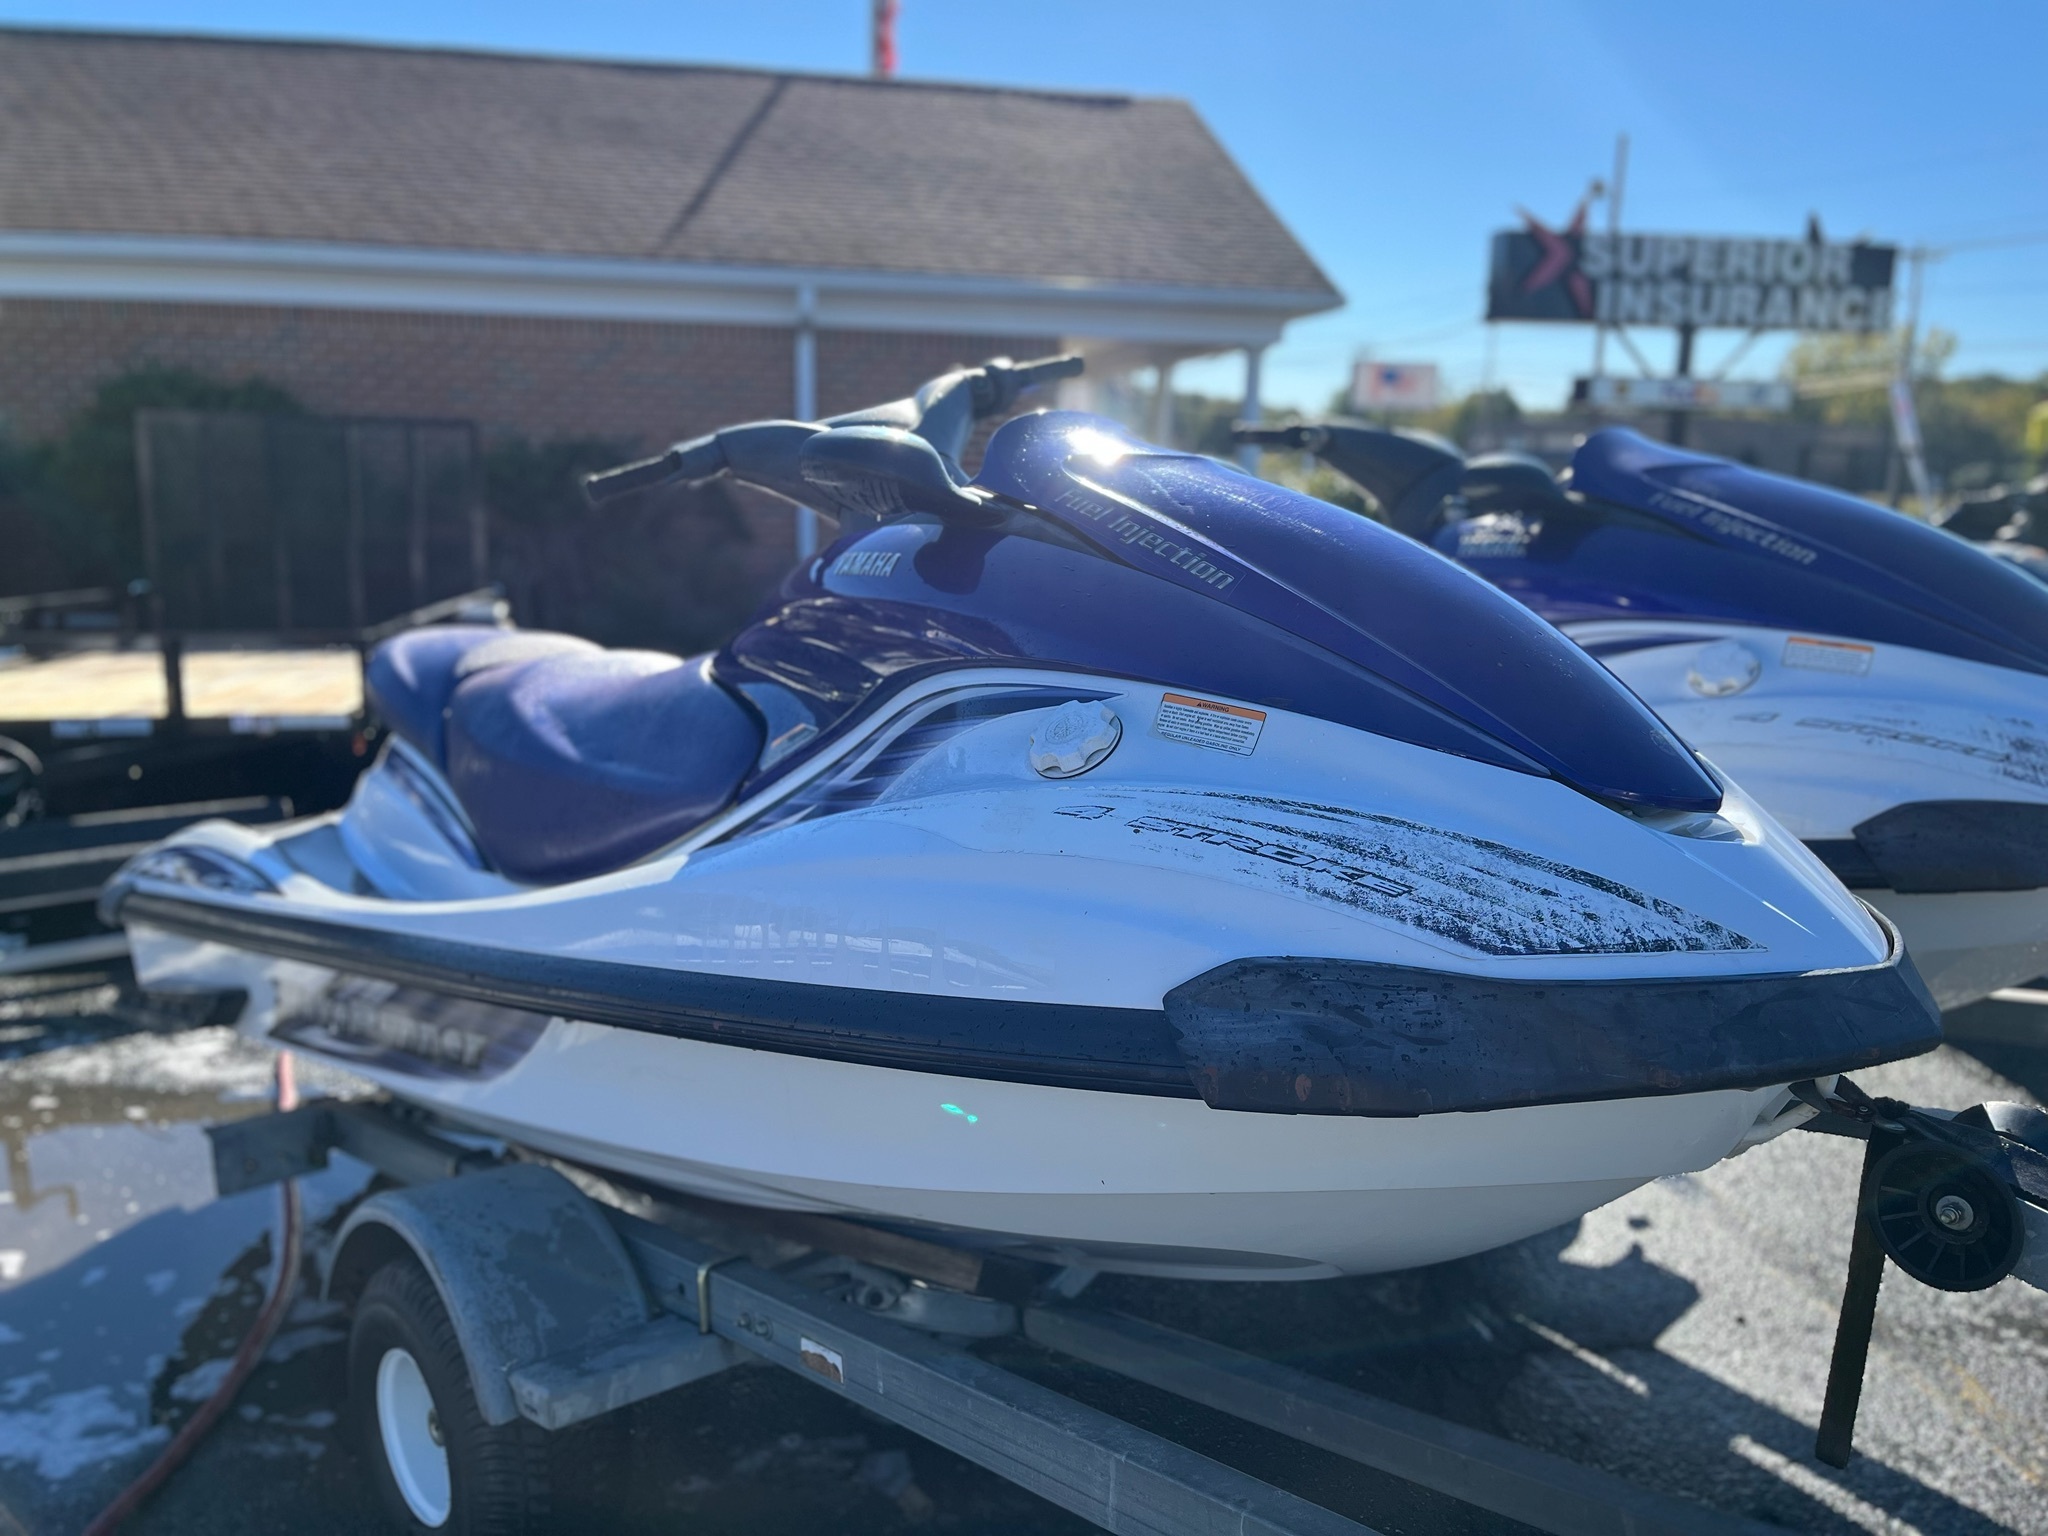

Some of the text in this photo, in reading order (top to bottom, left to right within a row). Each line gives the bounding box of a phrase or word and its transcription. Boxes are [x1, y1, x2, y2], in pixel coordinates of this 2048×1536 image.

[1579, 236, 1851, 284] SUPERIOR
[1054, 489, 1235, 590] Fuel Injection
[834, 552, 901, 577] YAMAHA
[1201, 702, 1230, 713] WARNING
[1181, 735, 1206, 744] UNLEADED
[1205, 740, 1229, 749] GASOLINE
[1228, 744, 1242, 752] ONLY
